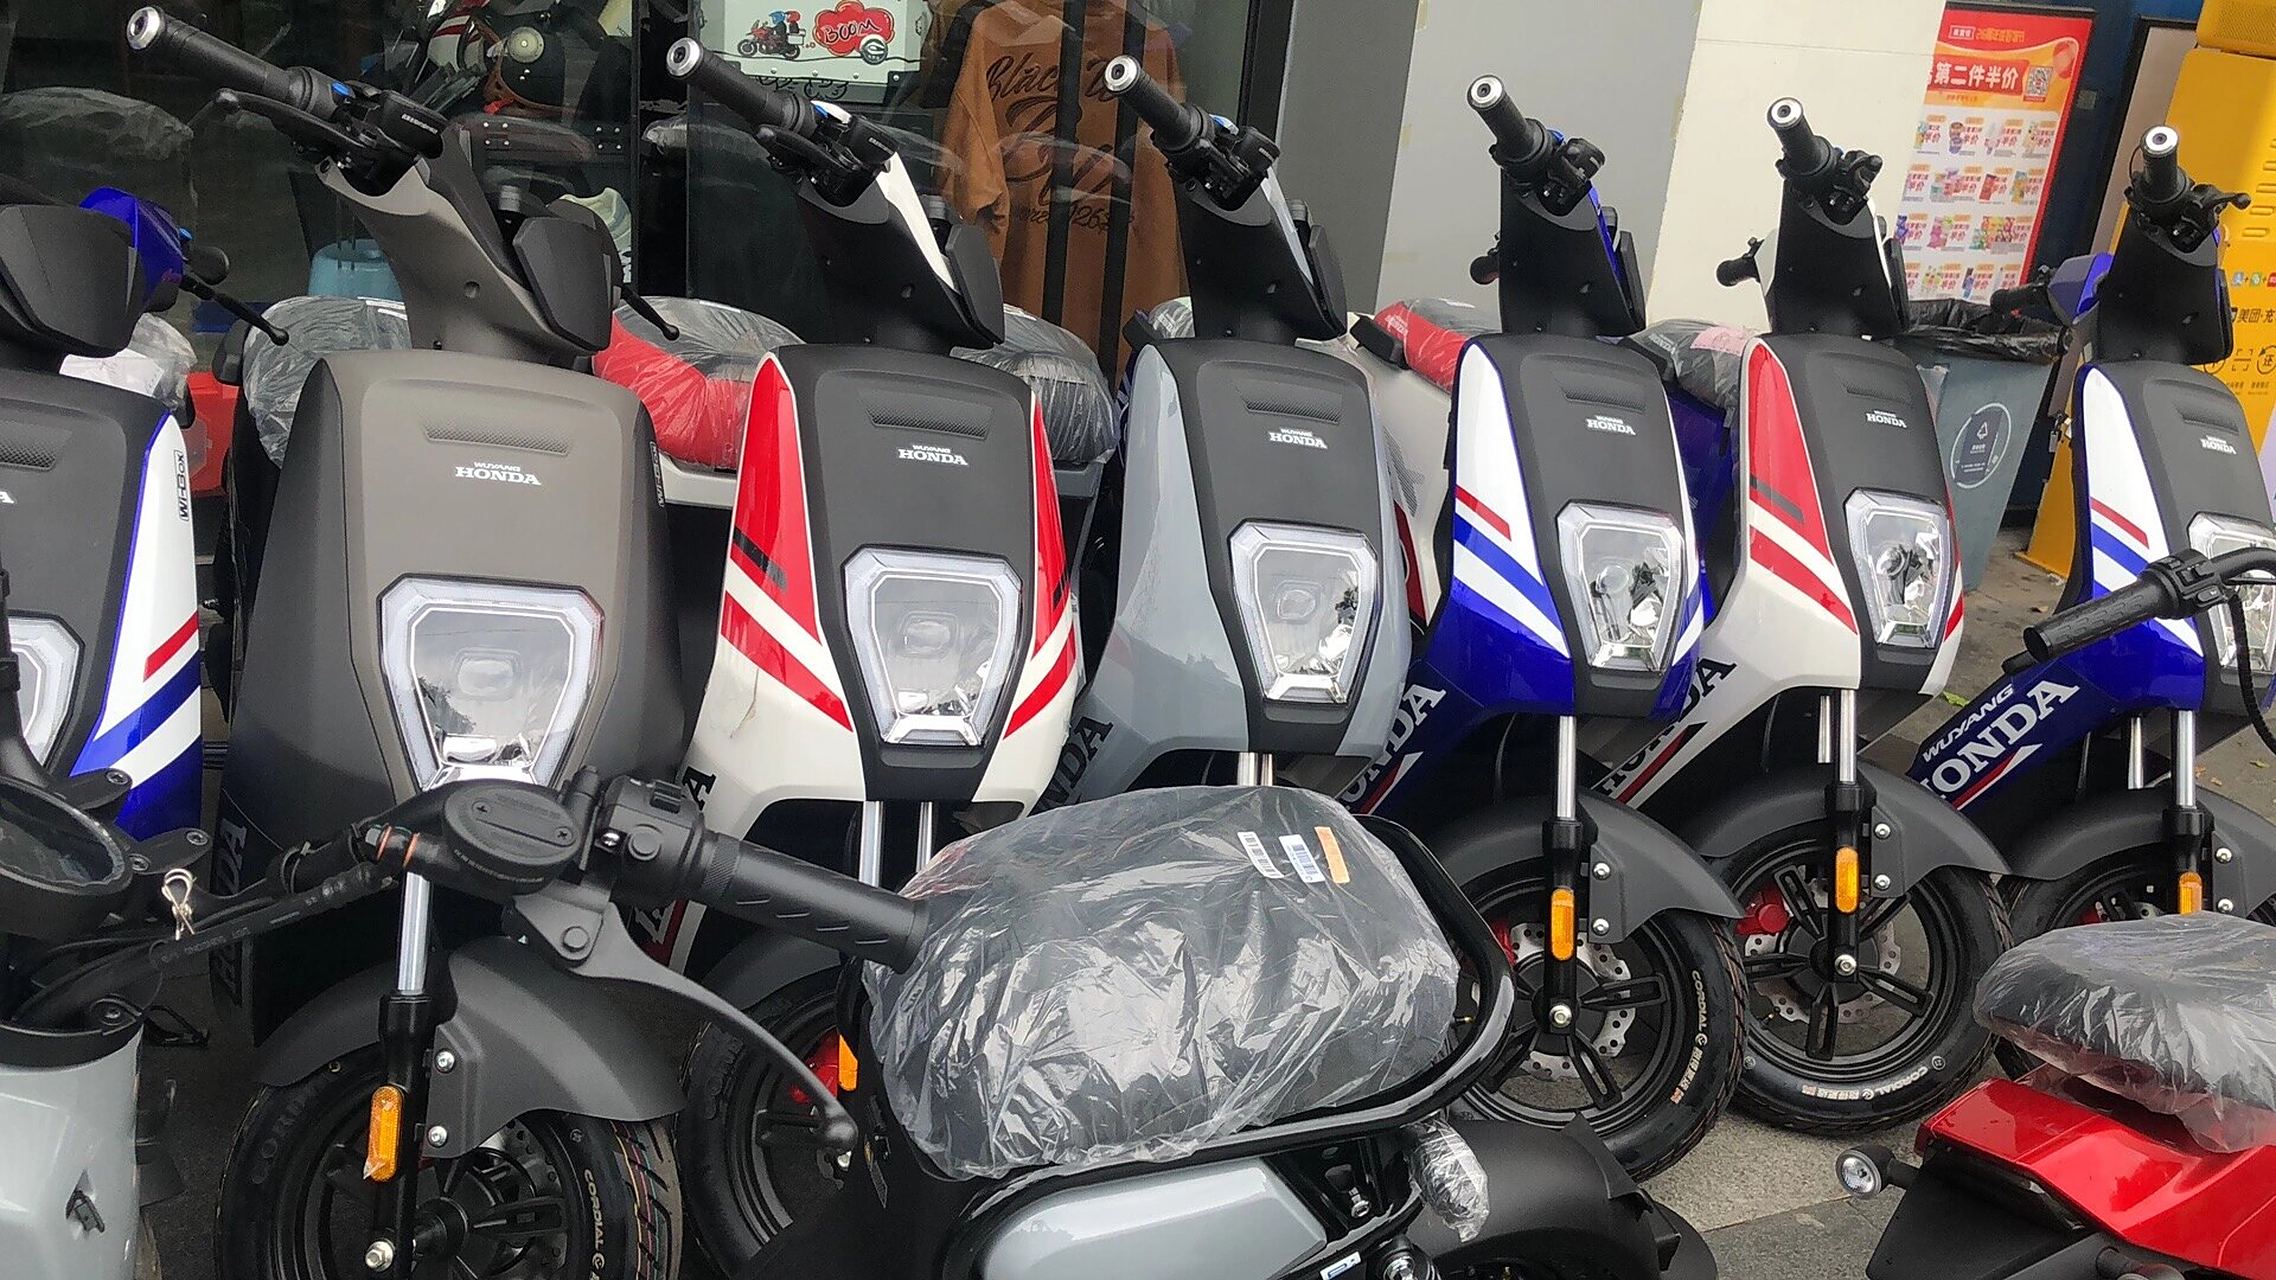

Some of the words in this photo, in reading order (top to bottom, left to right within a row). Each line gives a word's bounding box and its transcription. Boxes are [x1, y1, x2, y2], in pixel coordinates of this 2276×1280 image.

[824, 19, 881, 43] BOOM
[986, 52, 1060, 100] Blac
[1927, 60, 2019, 91] 第二件半价
[1585, 417, 1637, 436] HONDA
[1866, 412, 1908, 429] HONDA
[1268, 431, 1328, 450] HONDA
[2200, 438, 2237, 455] HONDA
[473, 461, 521, 472] WUYANG
[897, 448, 969, 466] HONDA
[455, 466, 542, 486] HONDA
[1922, 683, 2014, 762] WUYANG
[1919, 680, 2081, 800] ONDA
[1691, 969, 1708, 1032] CORDIAL
[1877, 1065, 1929, 1096] CORDIAL
[583, 1168, 605, 1251] CORDIAL
